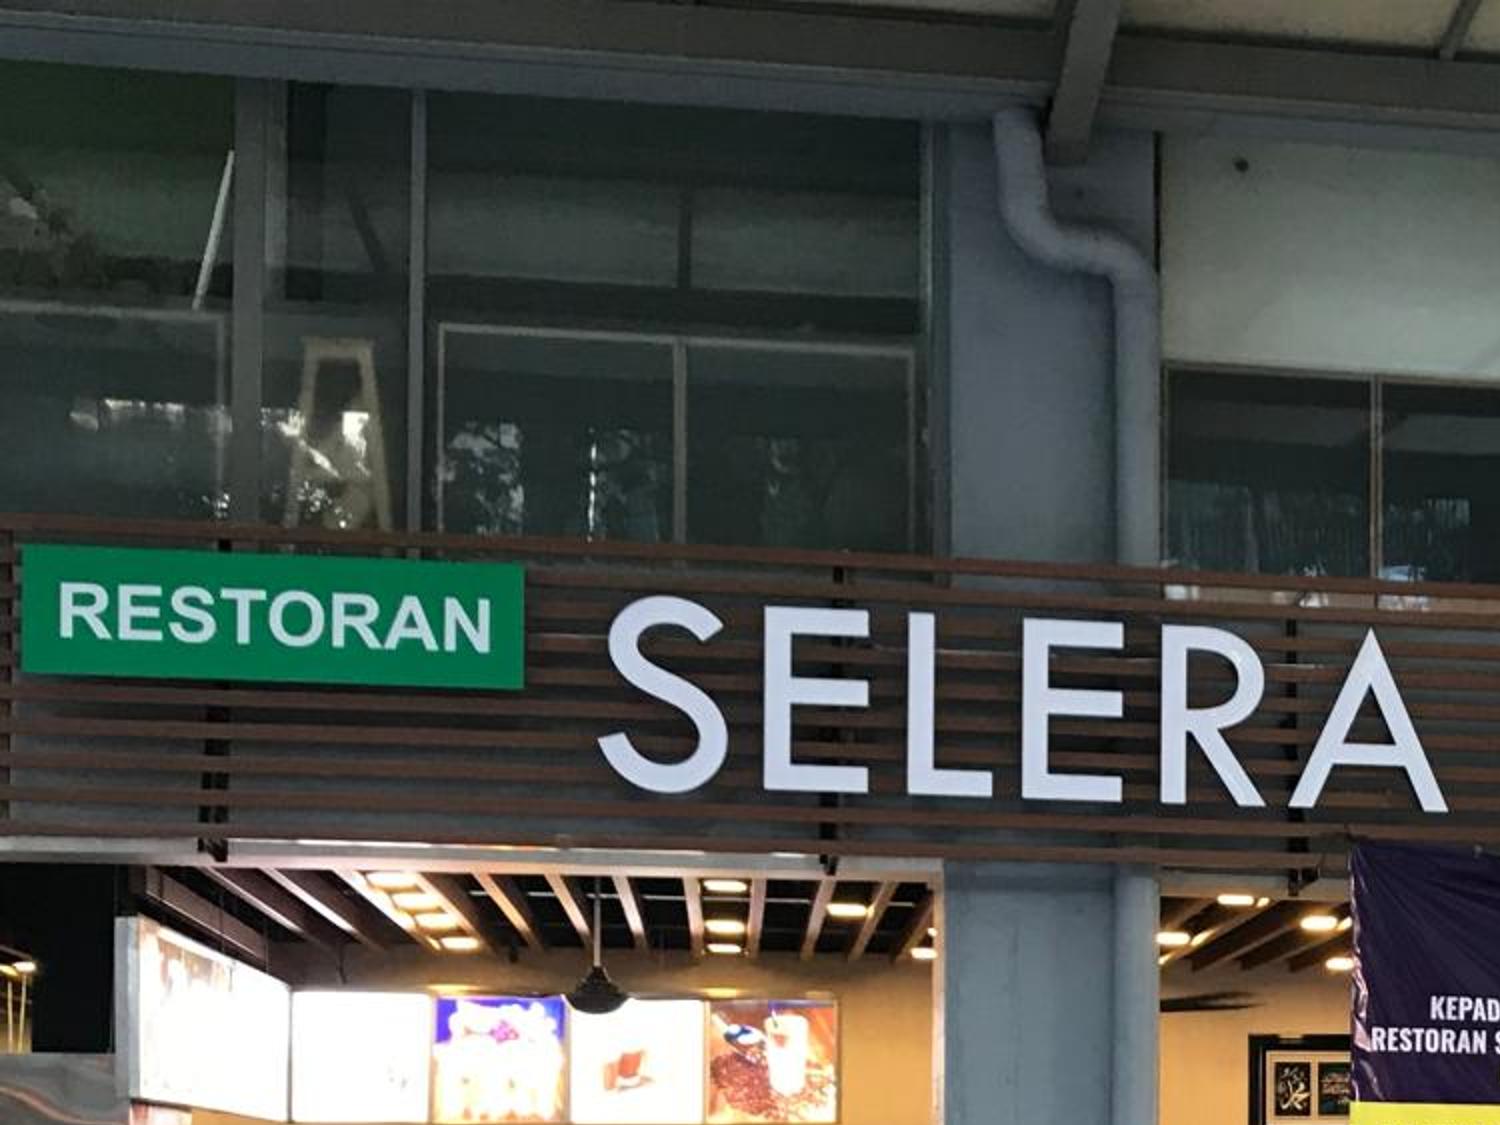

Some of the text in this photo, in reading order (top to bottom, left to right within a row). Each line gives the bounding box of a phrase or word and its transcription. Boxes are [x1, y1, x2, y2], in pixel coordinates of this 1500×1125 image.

[58, 581, 491, 653] RESTORAN
[597, 595, 1449, 813] SELERA
[1370, 1026, 1487, 1054] RESTORAN
